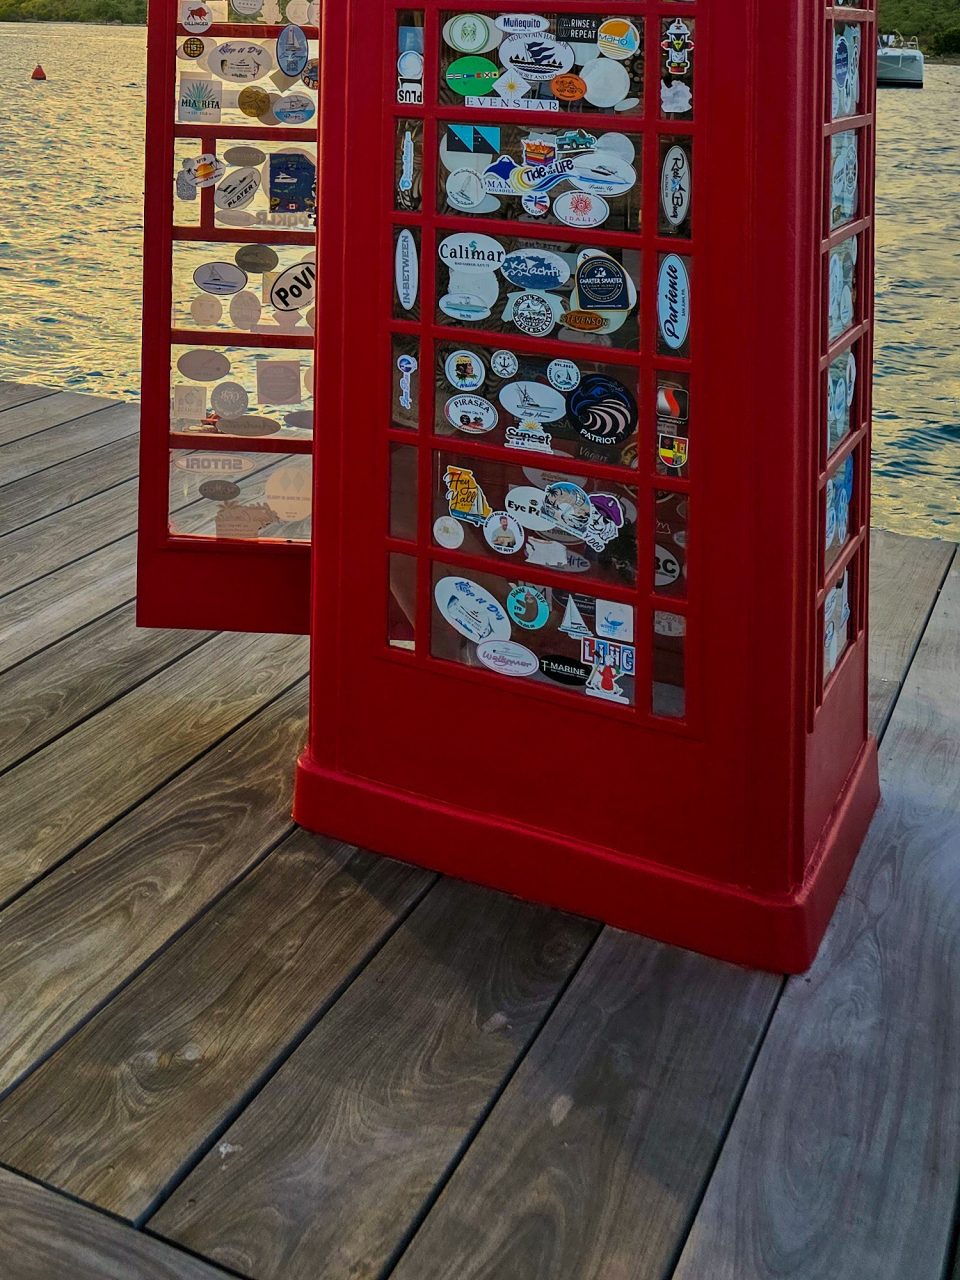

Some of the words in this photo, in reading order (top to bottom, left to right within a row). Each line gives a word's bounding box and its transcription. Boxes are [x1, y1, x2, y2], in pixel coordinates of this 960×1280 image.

[503, 17, 541, 29] Muñequito
[570, 29, 596, 39] REPEAT
[181, 99, 197, 108] MIA
[201, 98, 220, 109] RITA
[398, 89, 422, 102] PLUS
[227, 184, 254, 208] PLAYER
[439, 243, 504, 263] Calimar
[401, 235, 411, 304] IN-BETWEEN
[663, 264, 680, 340] Pariente
[560, 314, 608, 328] STEVENSON
[453, 398, 490, 414] PIRASEA
[507, 428, 551, 445] Sunset
[580, 428, 617, 444] PATRIOT
[444, 472, 478, 495] Hey
[487, 603, 505, 621] Dry
[550, 661, 586, 675] MARINE
